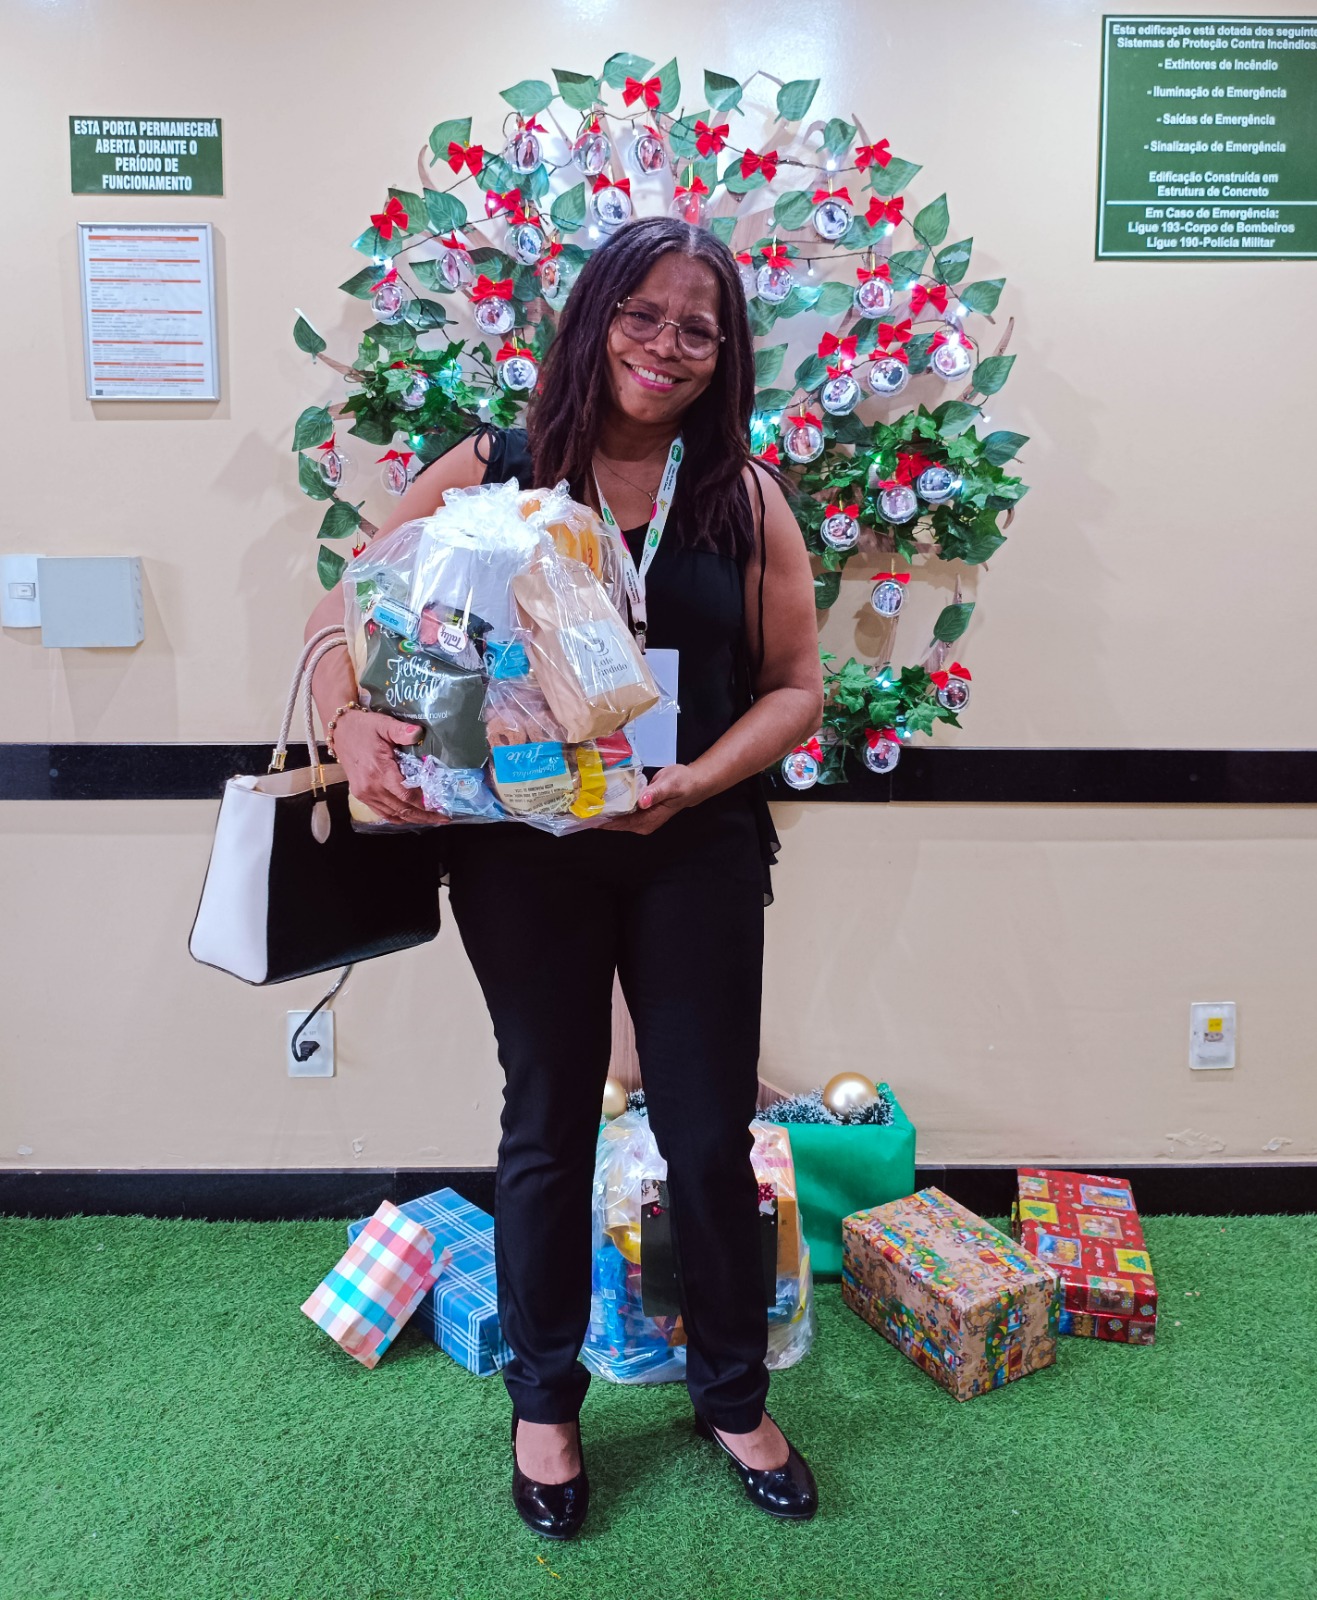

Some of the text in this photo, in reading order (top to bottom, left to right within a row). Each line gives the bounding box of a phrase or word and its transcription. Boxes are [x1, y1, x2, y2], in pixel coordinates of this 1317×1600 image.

[1113, 24, 1136, 35] Esta
[1138, 24, 1190, 37] edificação
[1193, 25, 1215, 35] está
[1217, 25, 1252, 36] dotada
[1255, 26, 1273, 36] dos
[1117, 37, 1164, 48] Sistemas
[1167, 38, 1180, 48] de
[1183, 38, 1228, 50] Proteção
[1231, 39, 1265, 49] Contra
[1219, 59, 1232, 70] de
[1235, 59, 1278, 71] Incêndio
[1211, 87, 1224, 97] de
[1227, 86, 1287, 100] Emergência
[74, 118, 218, 137] ESTA PORTA PERMANECERÁ
[1200, 114, 1213, 125] de
[1215, 114, 1276, 127] Emergência
[95, 139, 197, 155] ABERTA DURANTE O
[1211, 141, 1223, 152] de
[1226, 141, 1287, 154] Emergência
[115, 155, 179, 172] PERÍODO DE
[102, 174, 192, 191] FUNCIONAMENTO
[1149, 171, 1279, 184] Edificação Construída em
[1157, 185, 1269, 197] Estrutura de Concreto
[1145, 207, 1279, 221] Em Caso de Emergência:
[1128, 222, 1159, 235] Ligue
[1220, 222, 1234, 233] de
[1236, 222, 1295, 233] Bombeiros
[1147, 237, 1178, 250] Ligue
[1242, 237, 1275, 248] Militar
[440, 627, 462, 651] Tally
[387, 655, 431, 684] Feliz
[385, 677, 441, 707] Natal
[506, 744, 544, 764] Leite
